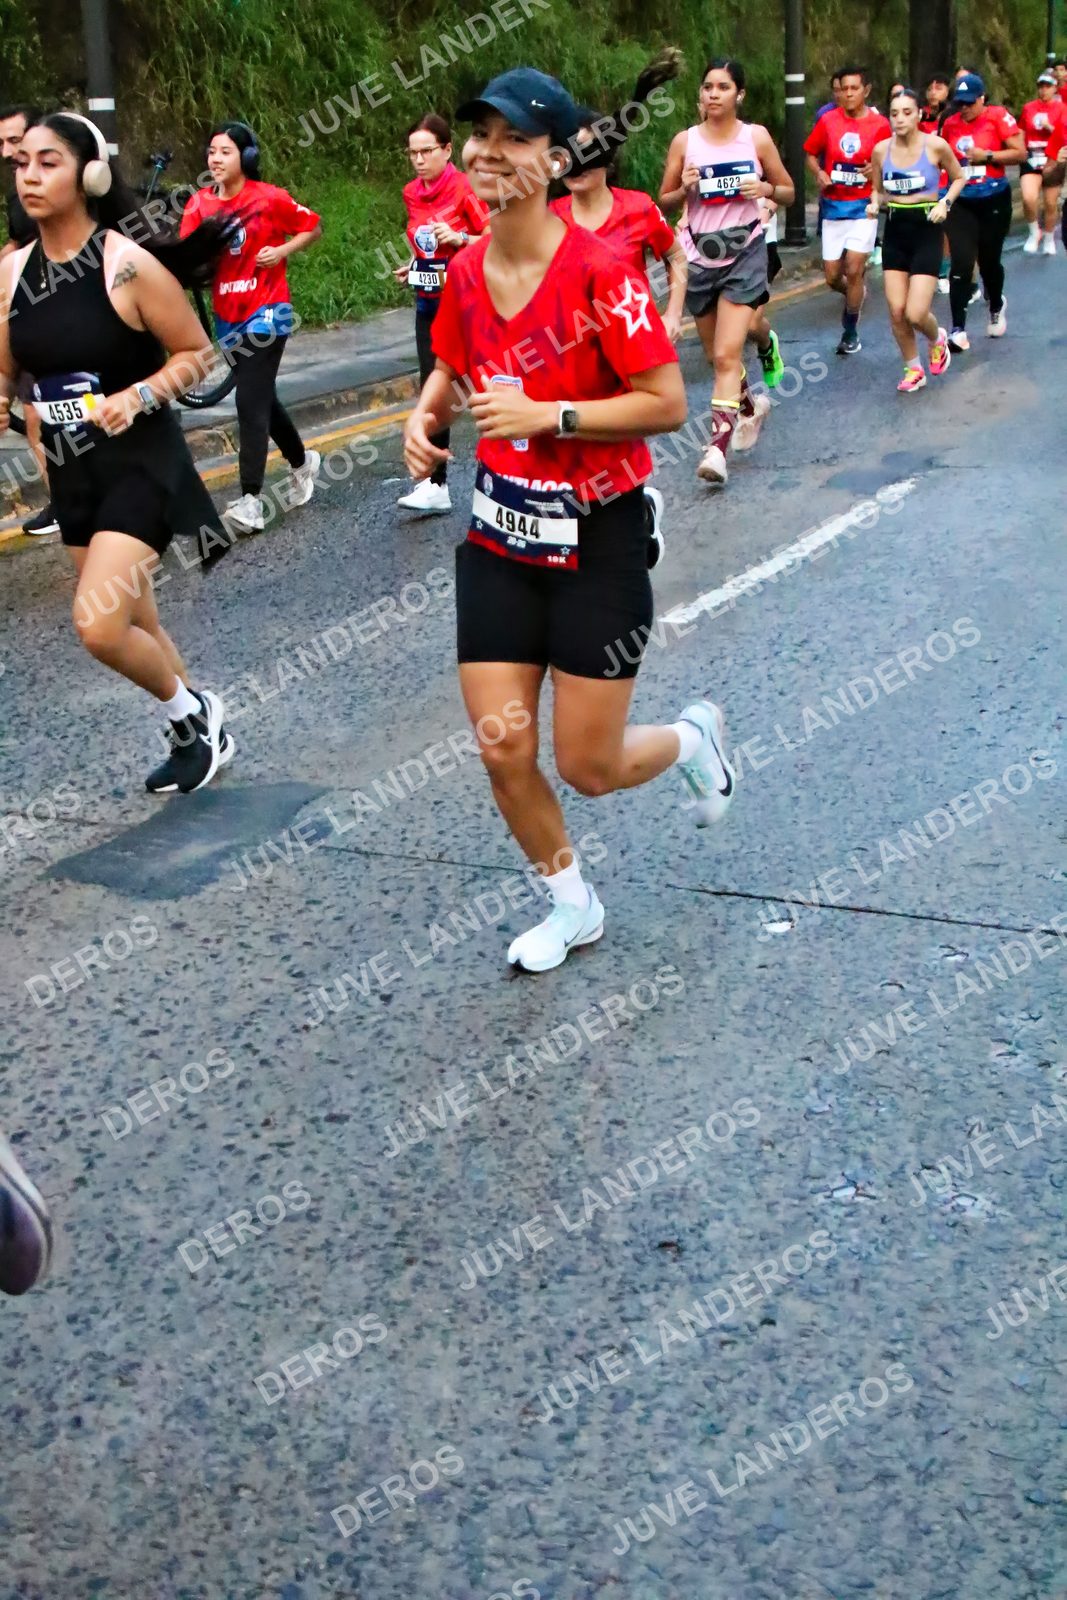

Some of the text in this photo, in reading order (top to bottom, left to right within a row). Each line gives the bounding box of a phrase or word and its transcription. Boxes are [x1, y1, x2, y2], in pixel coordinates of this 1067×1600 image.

[419, 274, 438, 284] 4230
[48, 401, 83, 422] 4535
[496, 506, 540, 539] 4944
